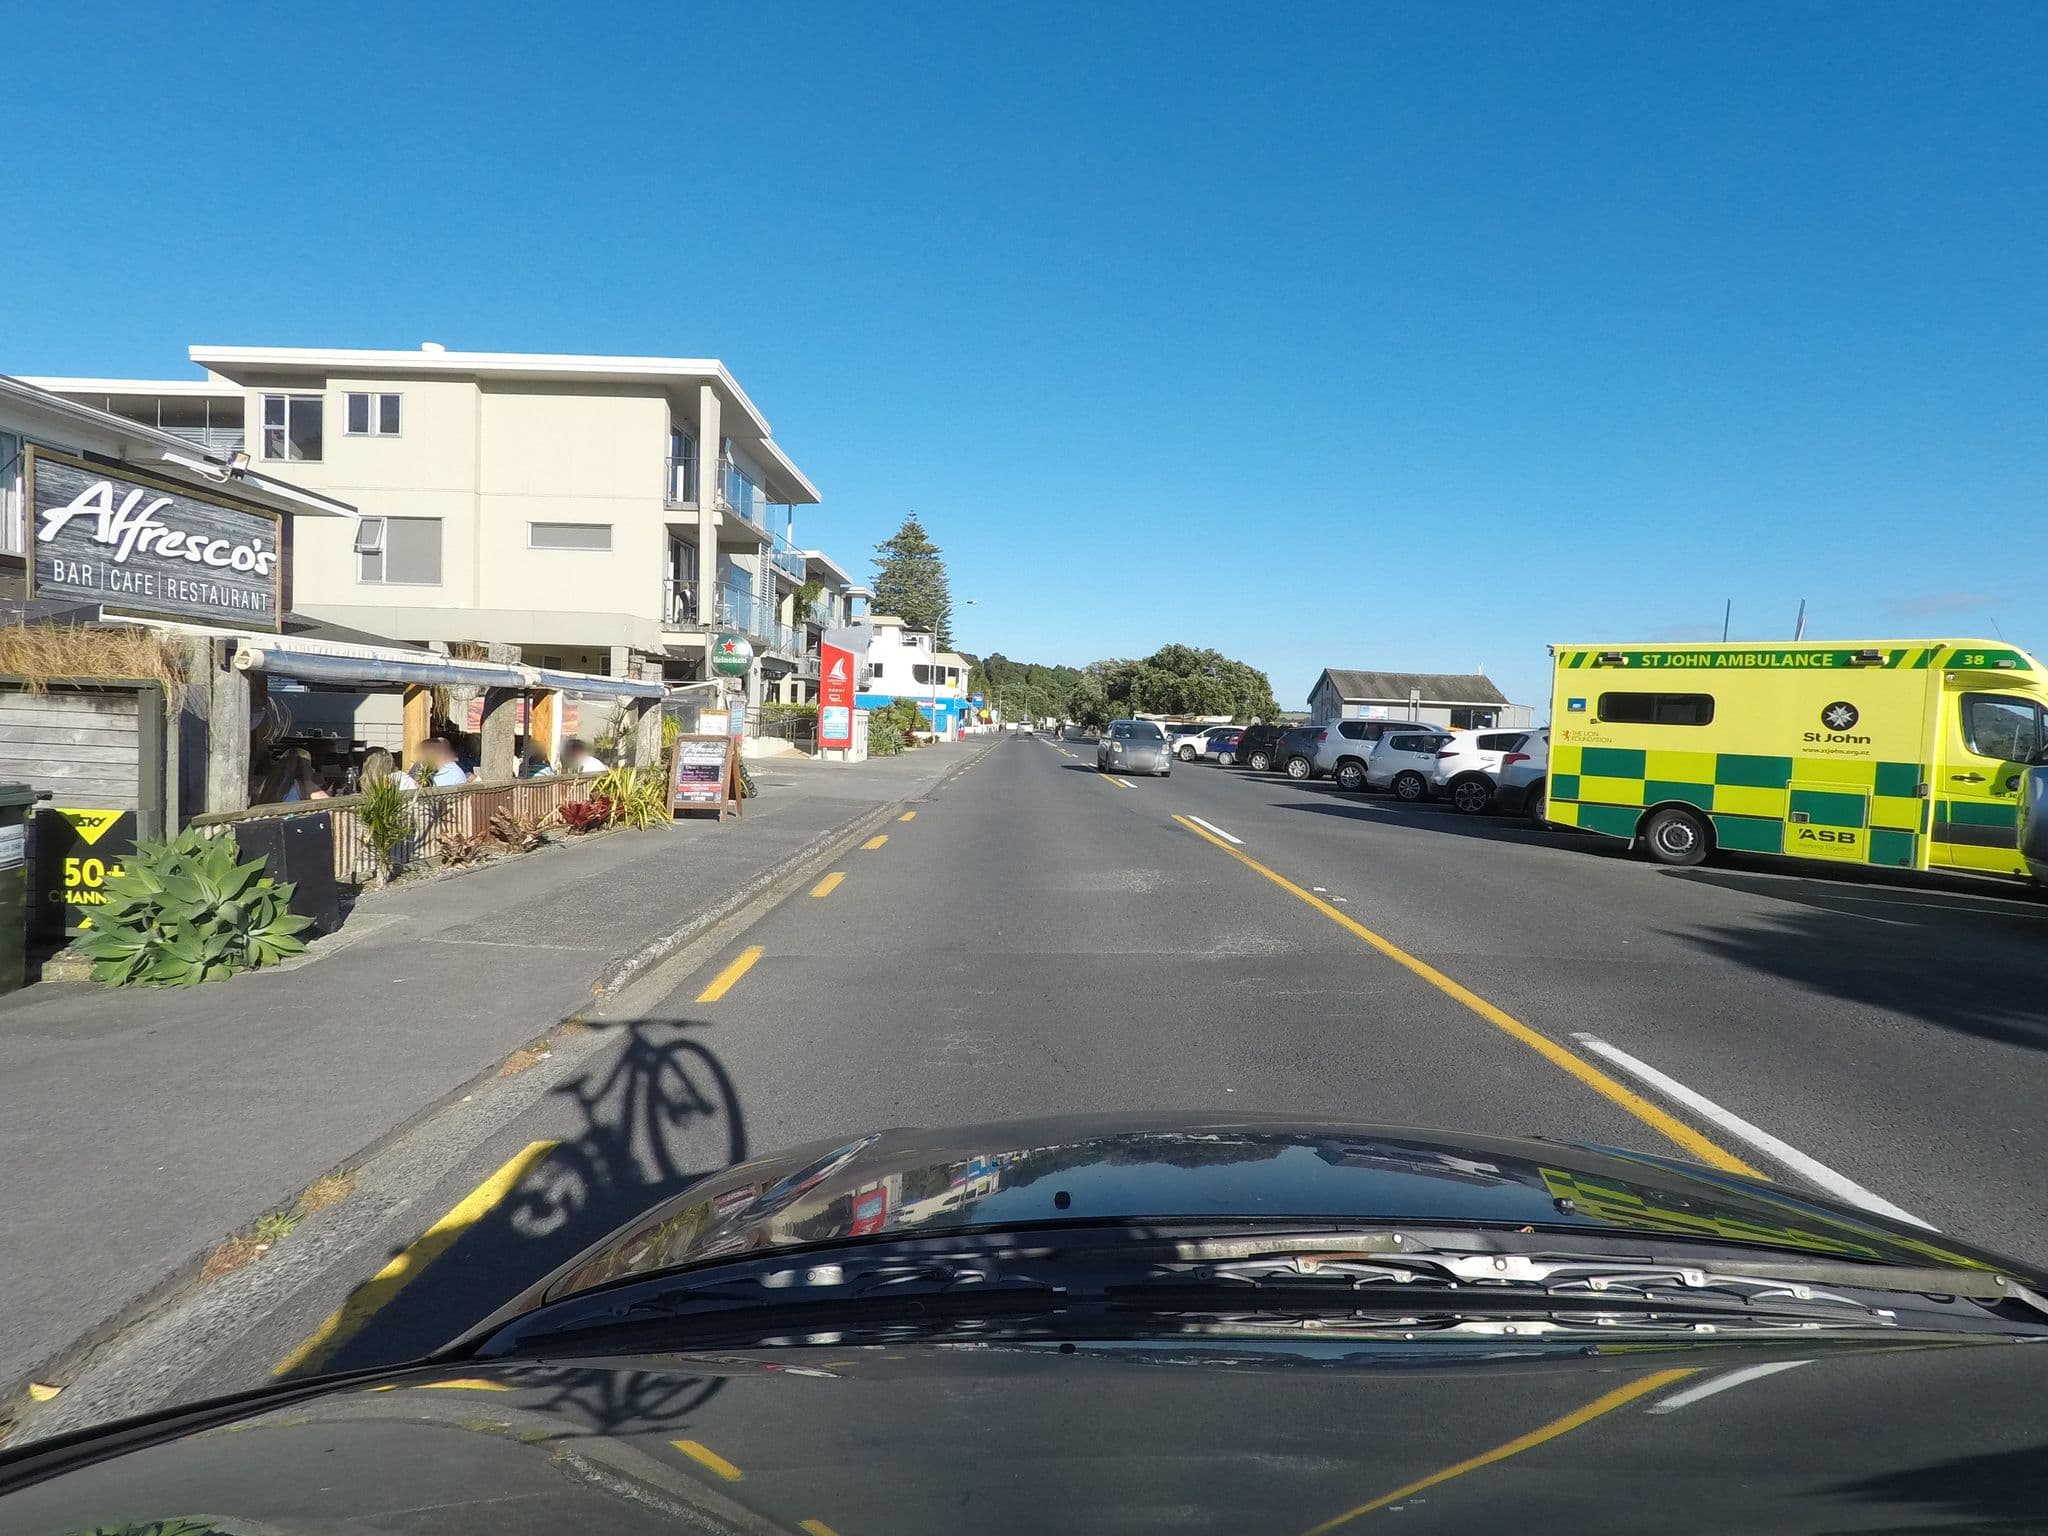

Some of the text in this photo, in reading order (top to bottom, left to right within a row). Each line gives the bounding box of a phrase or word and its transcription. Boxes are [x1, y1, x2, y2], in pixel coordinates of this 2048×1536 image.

[38, 481, 276, 575] Alfresco's
[53, 559, 268, 611] BAR CAFE RESTAURANT
[1642, 654, 1833, 666] ST JOHN AMBULANCE
[1963, 655, 1984, 665] 38
[1803, 732, 1871, 744] St John
[76, 817, 107, 827] SKY
[1799, 829, 1856, 844] ASB
[65, 858, 125, 887] 50+
